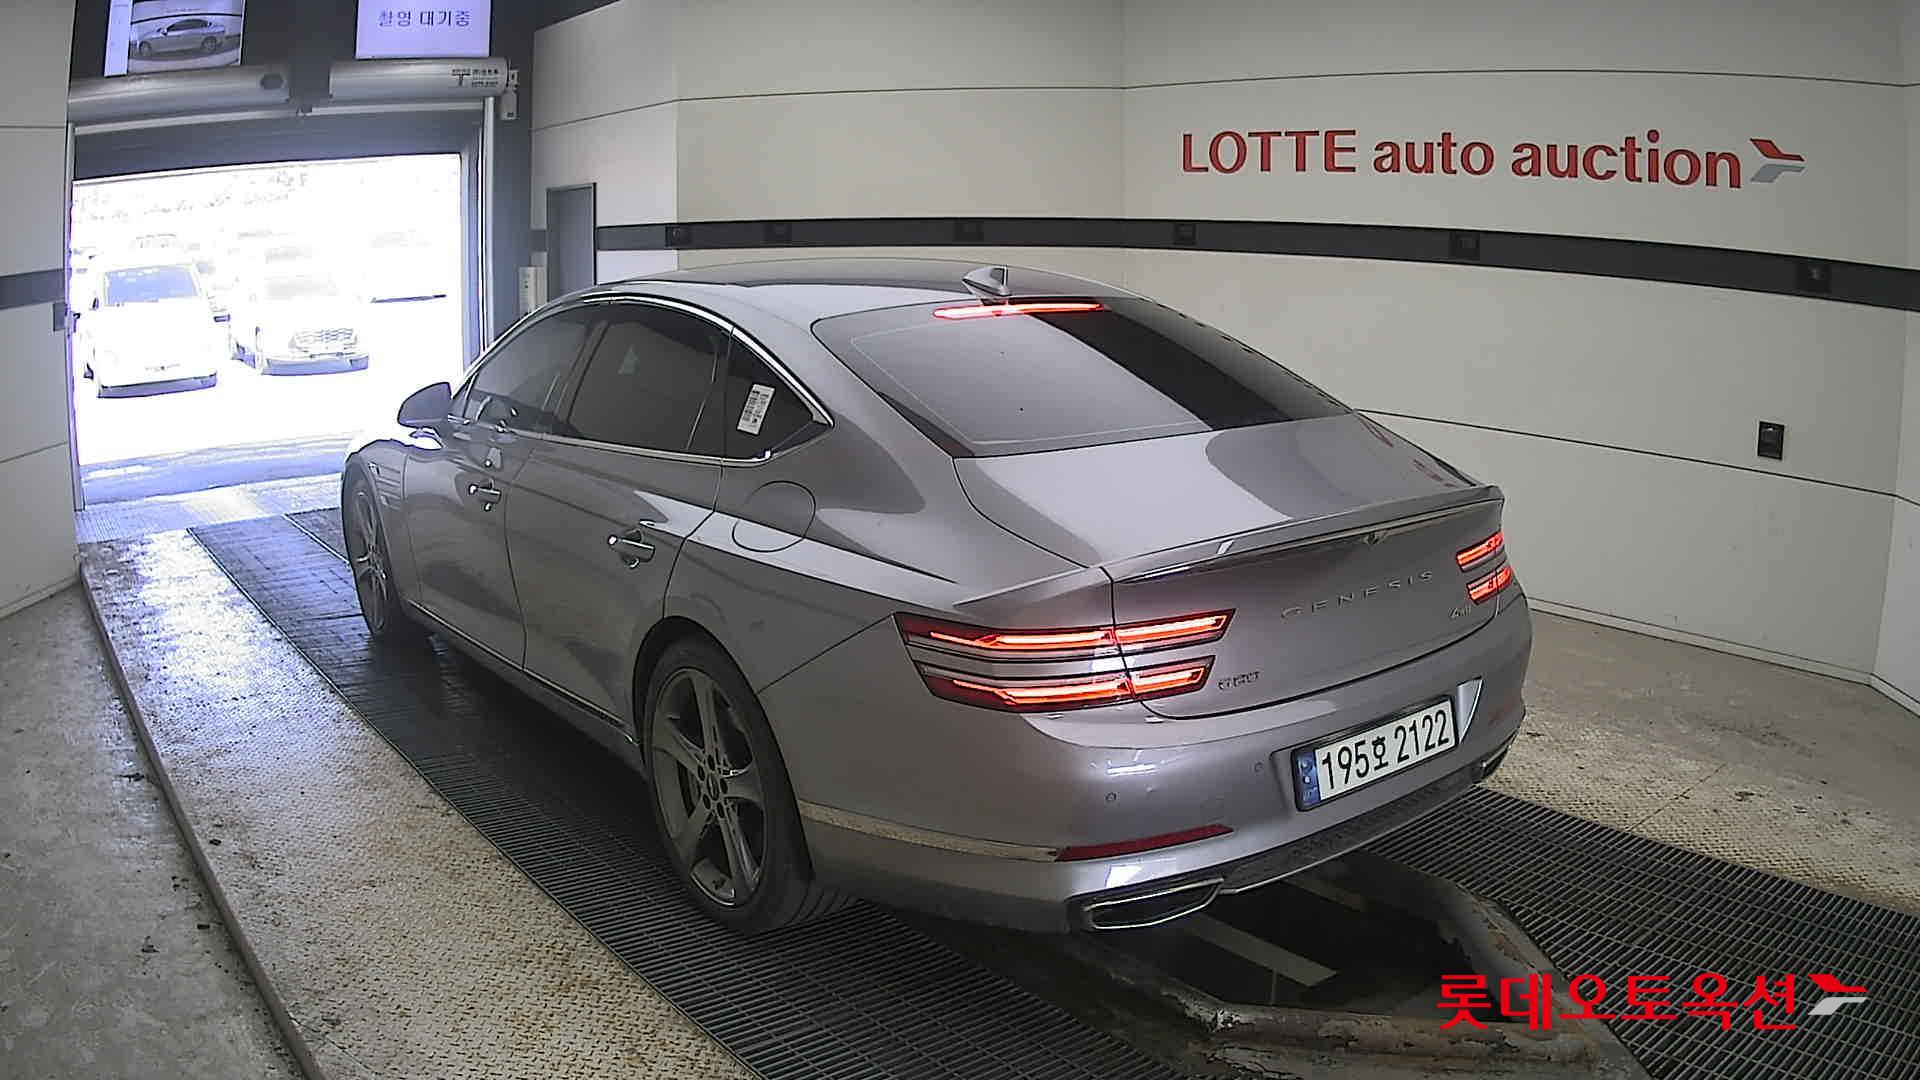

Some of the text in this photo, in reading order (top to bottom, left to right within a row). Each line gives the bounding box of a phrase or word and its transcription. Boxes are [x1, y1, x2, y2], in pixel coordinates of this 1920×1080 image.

[420, 10, 471, 27] 대기중
[1183, 129, 1742, 189] LOTTE auto auction
[1322, 709, 1450, 789] 195호 2122
